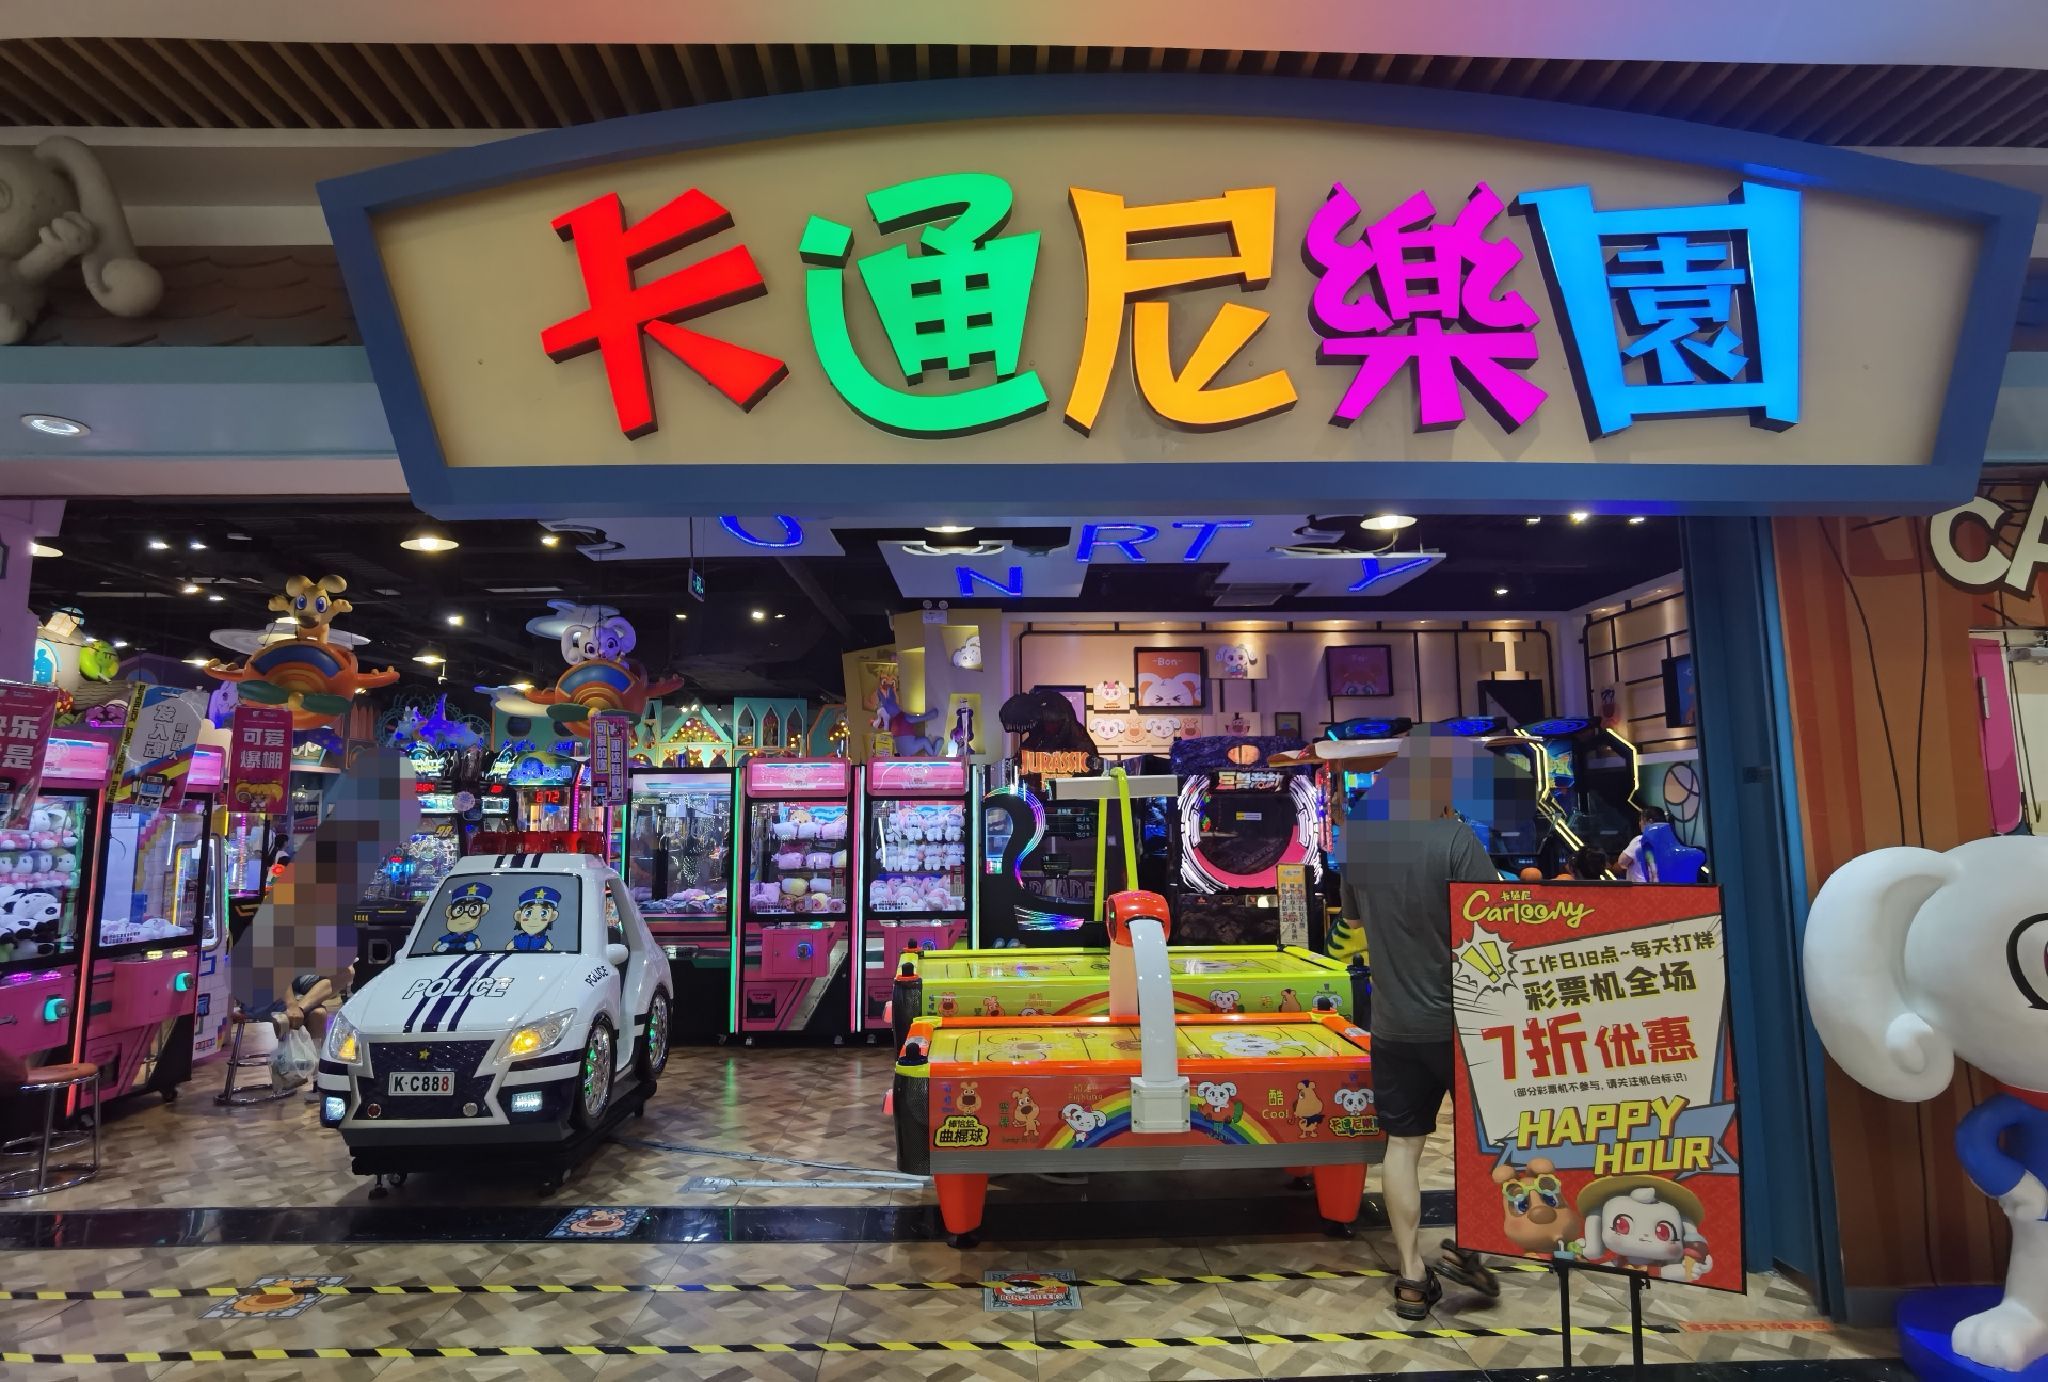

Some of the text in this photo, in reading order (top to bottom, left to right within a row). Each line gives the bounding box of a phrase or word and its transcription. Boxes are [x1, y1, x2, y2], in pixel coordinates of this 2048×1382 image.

[541, 172, 1803, 441] 卡通尼樂園
[243, 728, 285, 747] 可爱
[0, 743, 34, 769] 是
[240, 751, 283, 770] 爆棚
[1021, 750, 1090, 775] JURASSIC
[1501, 890, 1532, 901] 卡通尼
[585, 965, 610, 988] POLICE
[1522, 961, 1698, 1011] 彩票机全场
[402, 977, 515, 1000] POLICE
[1268, 1089, 1284, 1106] 酷
[1262, 1109, 1289, 1120] Cool
[1517, 1095, 1690, 1150] HAPPY
[940, 1129, 984, 1143] 曲棍球
[1594, 1136, 1714, 1176] HOUR
